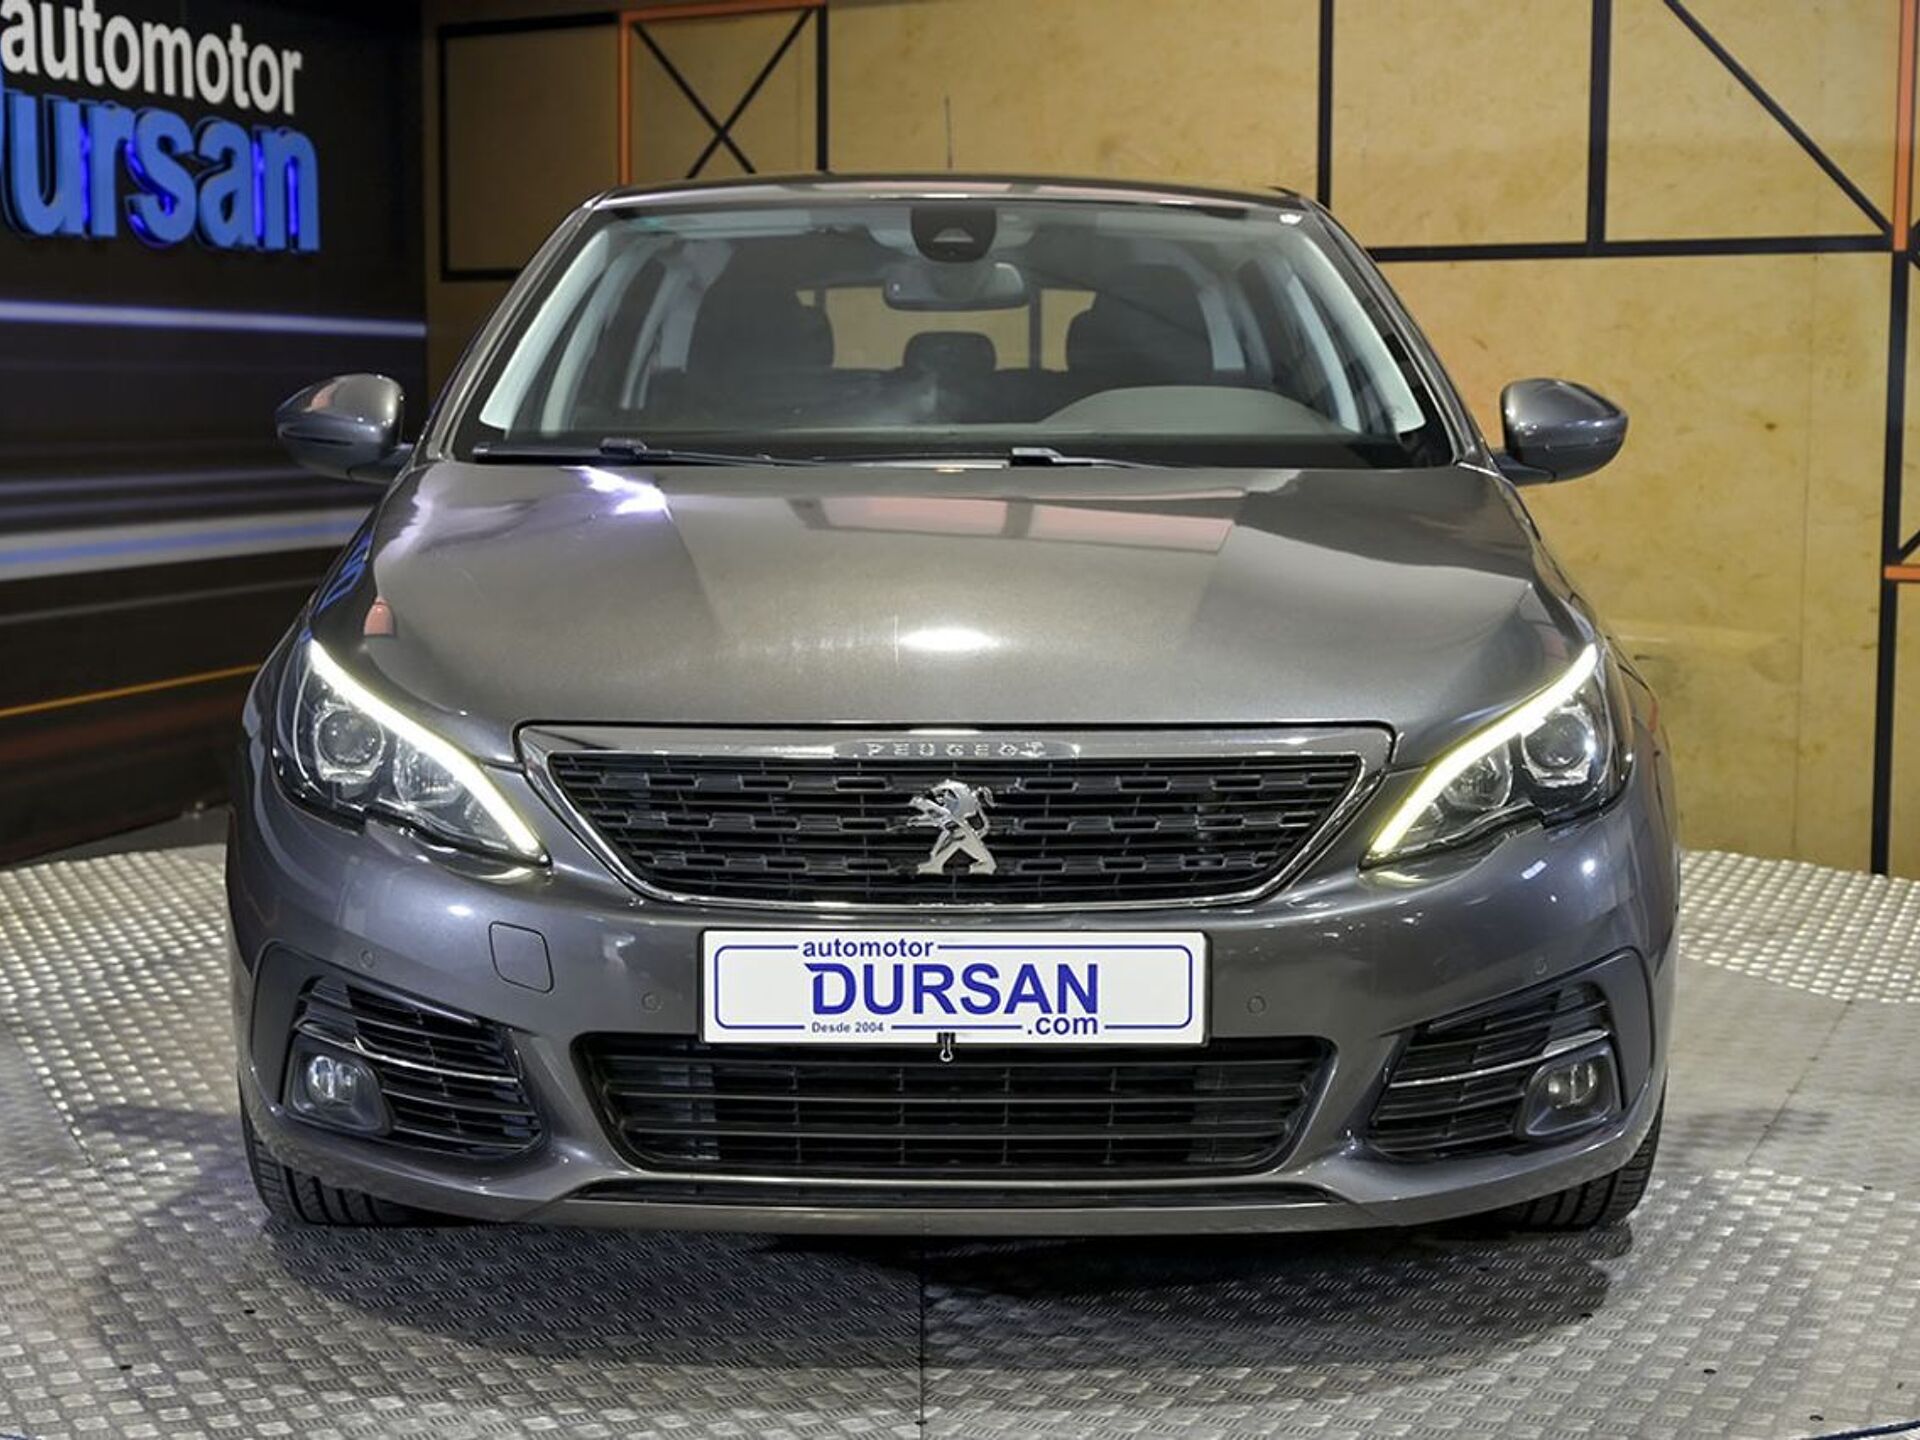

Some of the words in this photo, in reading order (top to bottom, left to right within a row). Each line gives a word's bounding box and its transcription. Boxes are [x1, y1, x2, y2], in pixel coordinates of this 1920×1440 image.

[0, 0, 302, 115] automotor
[0, 84, 320, 252] ursan
[803, 938, 934, 958] automotor
[804, 963, 1099, 1015] DURSAN
[811, 1022, 852, 1034] Desde
[855, 1022, 885, 1034] 2004
[1027, 1016, 1099, 1036] .com
